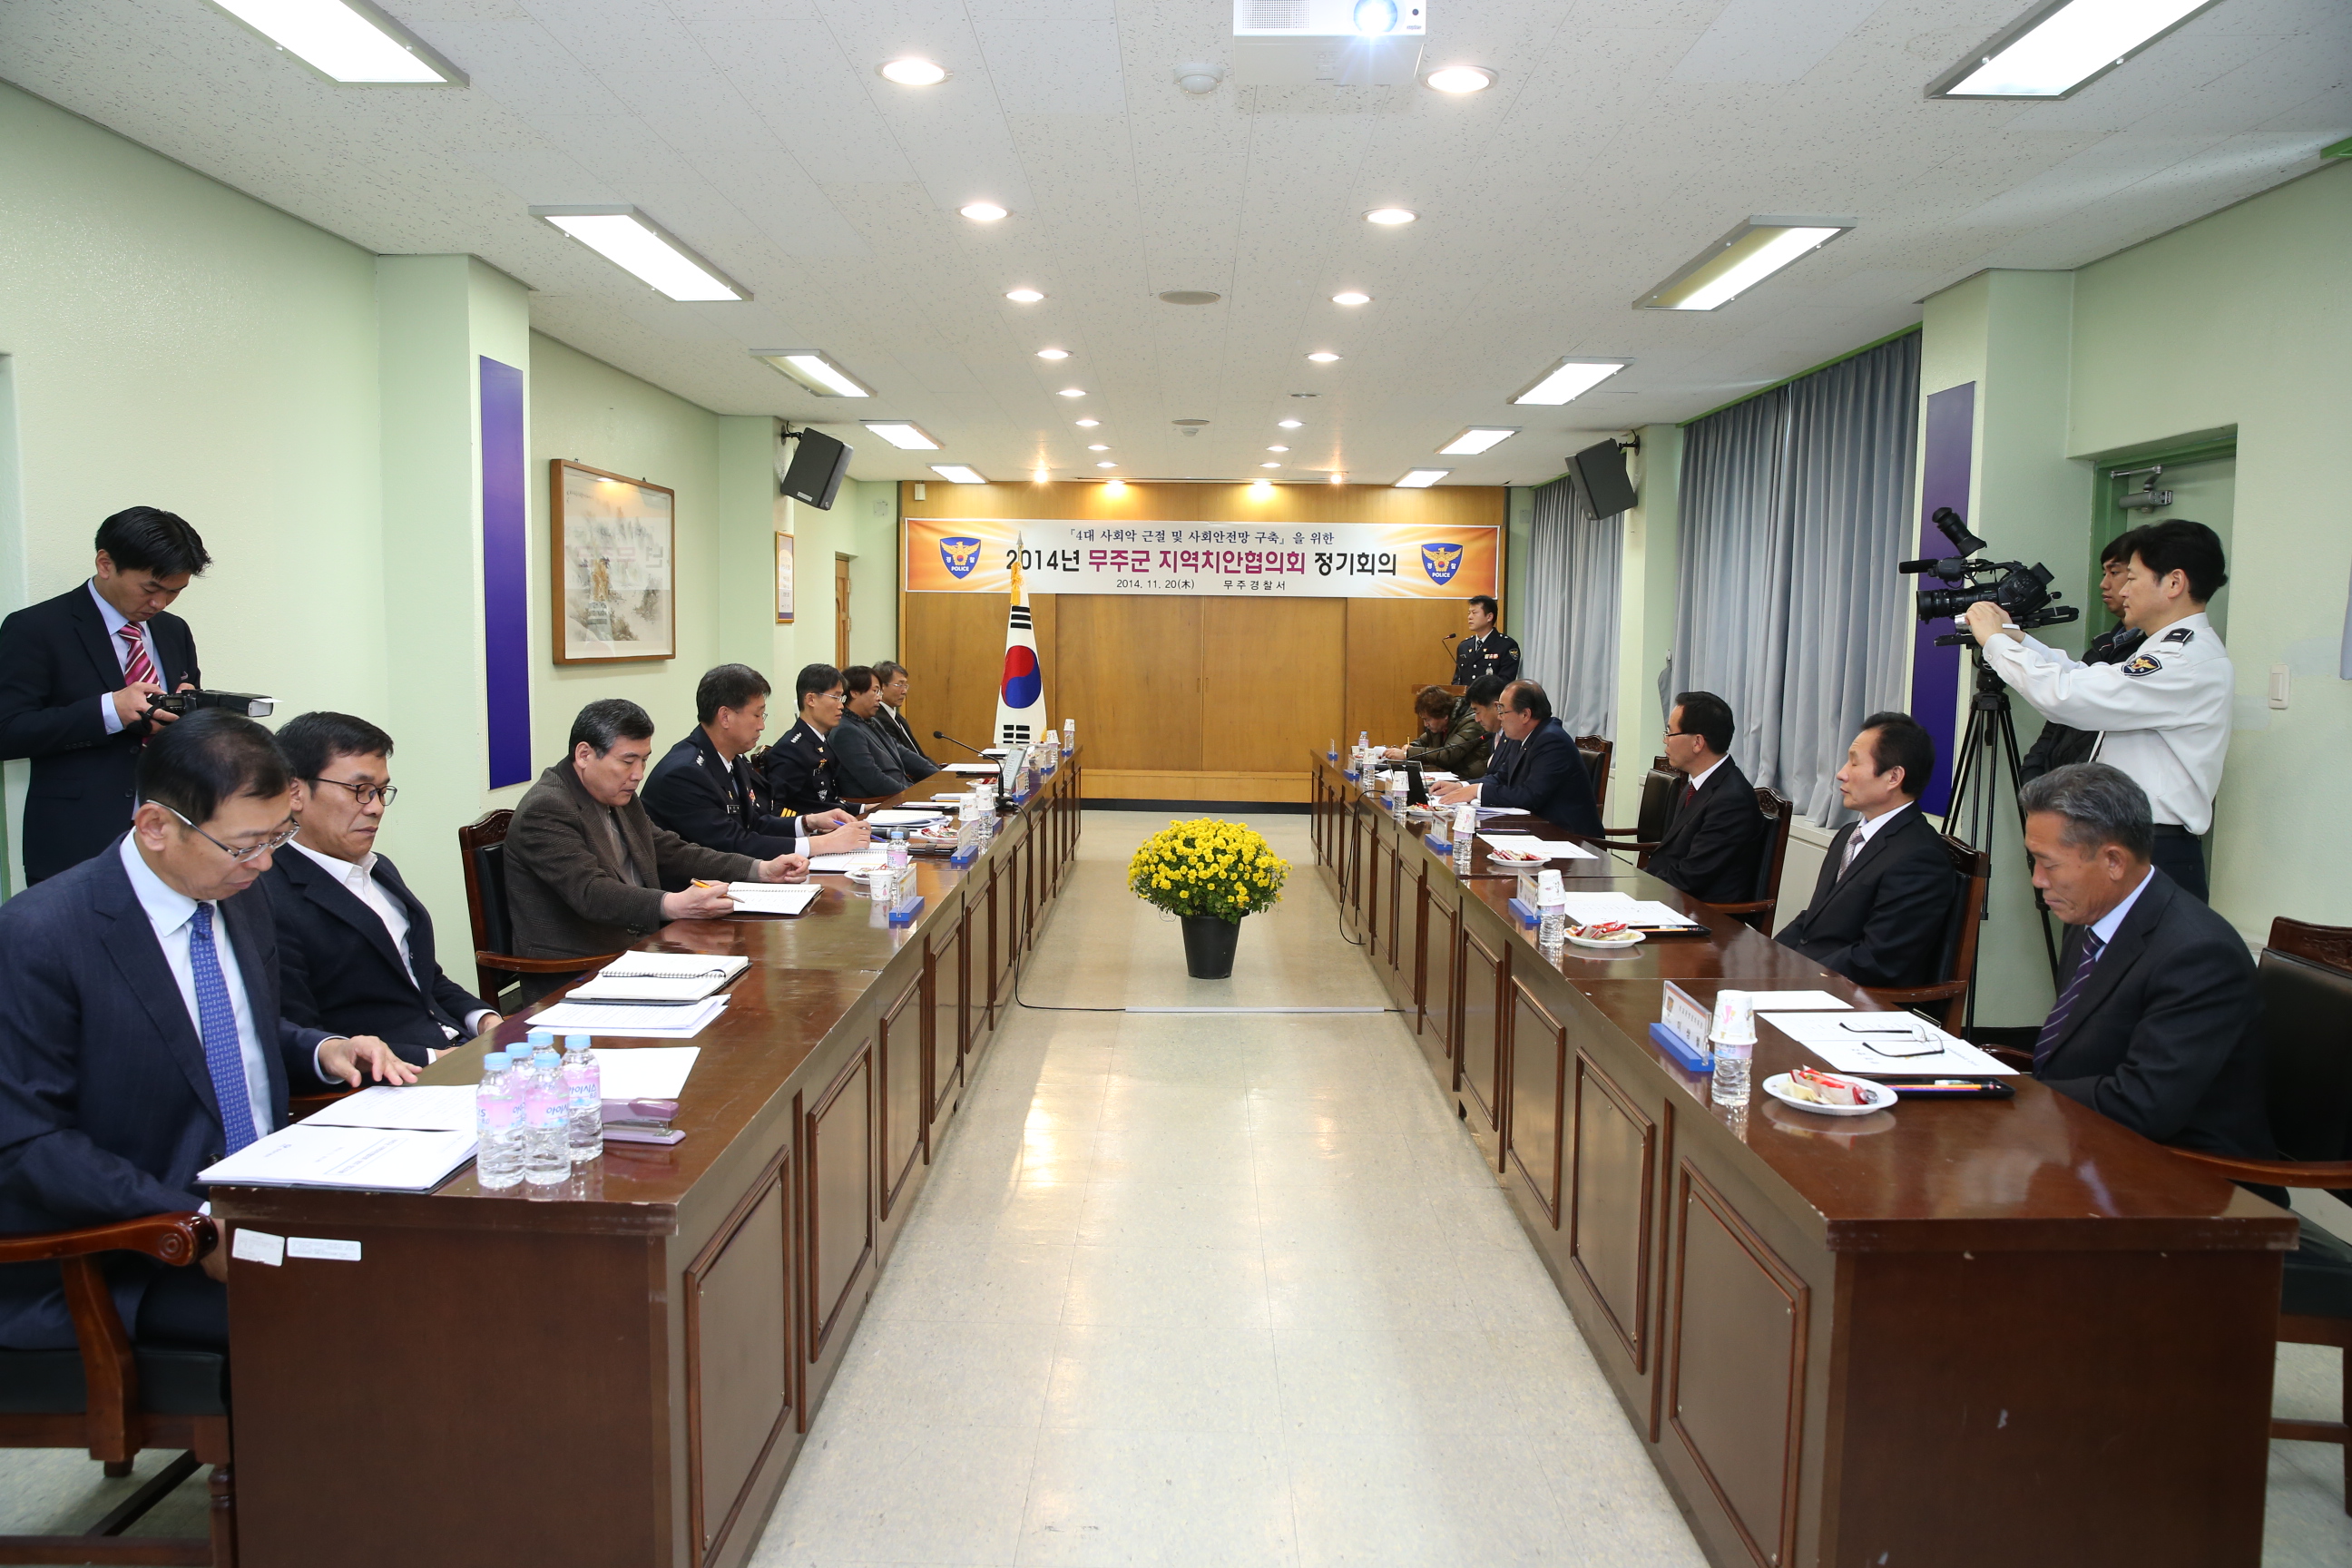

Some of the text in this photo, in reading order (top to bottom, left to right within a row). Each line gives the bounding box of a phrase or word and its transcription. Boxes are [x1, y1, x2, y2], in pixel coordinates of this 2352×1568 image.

[1101, 529, 1137, 543] 사회악
[1142, 530, 1166, 543] 근절
[1172, 530, 1183, 543] 및
[1189, 531, 1250, 544] 사회안전망
[1310, 532, 1335, 544] 위한
[1006, 549, 1396, 576] 2014년 무주군 지역치안협의회 정기회의
[1117, 579, 1195, 591] 2014. 11. 20(木)
[1223, 580, 1286, 591] 무주경찰서
